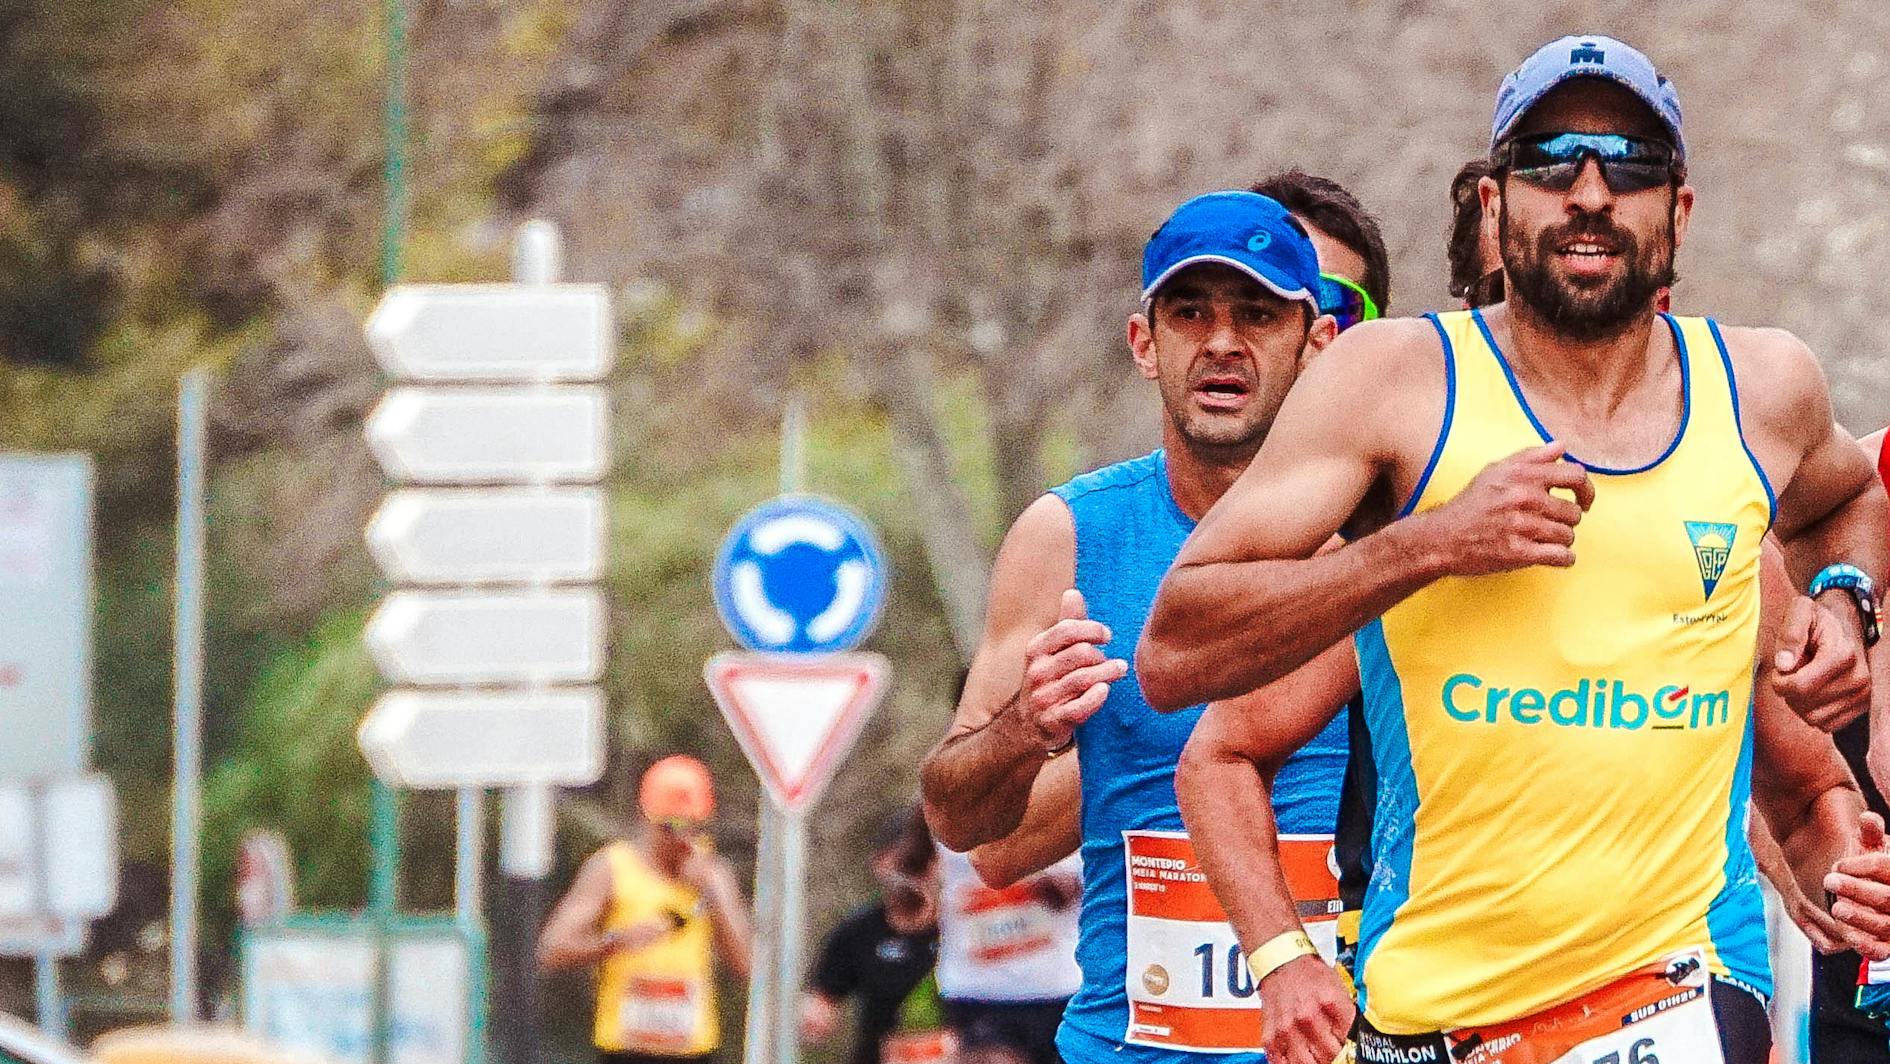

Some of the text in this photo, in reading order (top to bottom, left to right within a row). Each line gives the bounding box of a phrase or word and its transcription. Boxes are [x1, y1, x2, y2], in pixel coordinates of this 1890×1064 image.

[1442, 673, 1729, 731] Credibom
[1131, 856, 1187, 870] MONTEPIO
[1133, 868, 1207, 883] MEIA MARATON
[1360, 1042, 1437, 1064] TRIATHLON
